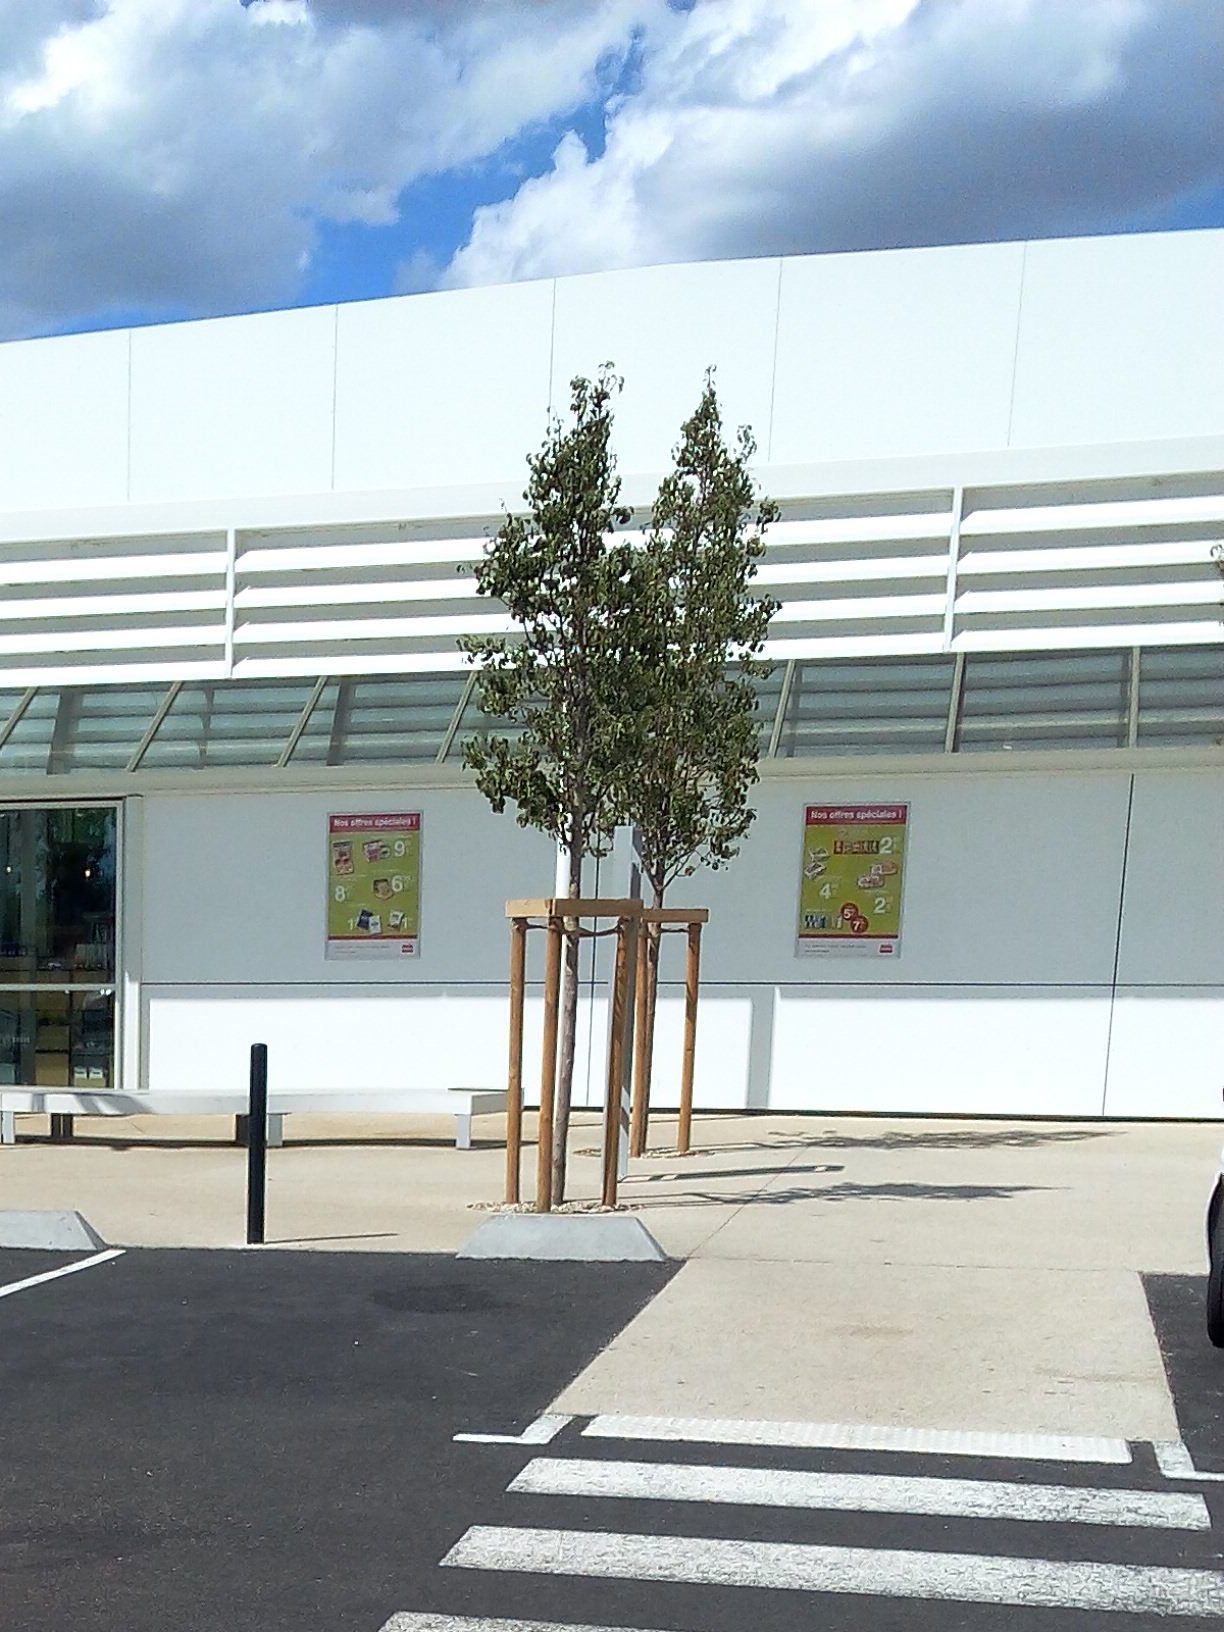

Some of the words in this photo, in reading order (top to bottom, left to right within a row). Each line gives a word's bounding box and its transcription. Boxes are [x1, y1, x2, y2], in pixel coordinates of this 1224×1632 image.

[811, 811, 827, 819] Nos
[829, 810, 854, 819] offres
[334, 819, 349, 827] Nos
